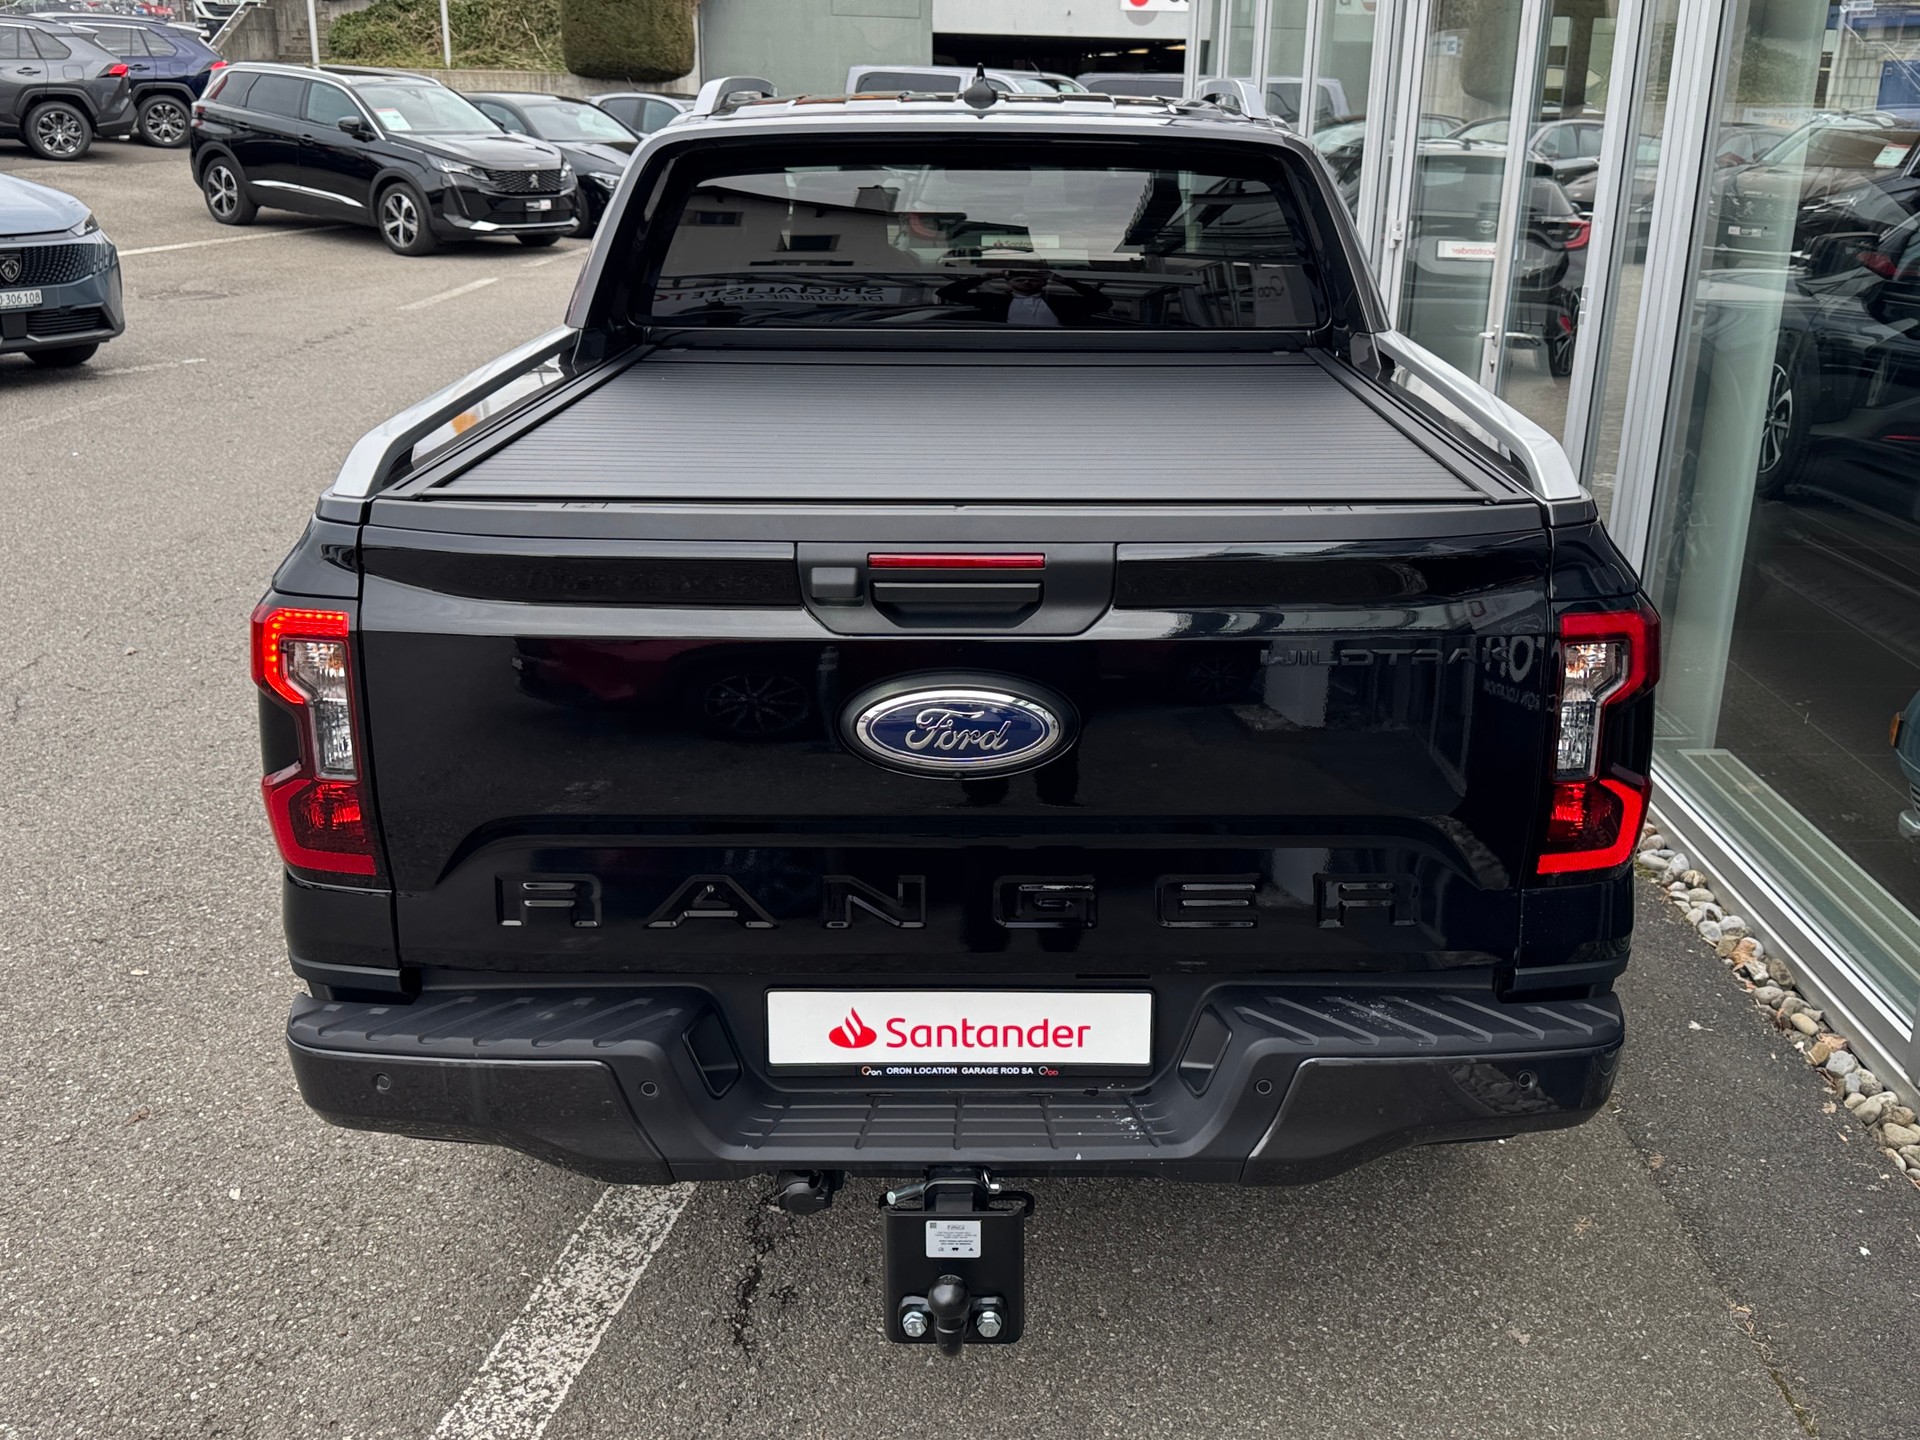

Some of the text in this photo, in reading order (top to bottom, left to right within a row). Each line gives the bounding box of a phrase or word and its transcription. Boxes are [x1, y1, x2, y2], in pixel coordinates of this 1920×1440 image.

[905, 708, 1011, 751] Ford
[495, 871, 1422, 928] RANGER
[886, 1018, 1091, 1049] Santander
[886, 1066, 912, 1075] ORON
[913, 1066, 958, 1075] LOCATION
[961, 1066, 999, 1075] GARAGE
[1000, 1066, 1020, 1075] ROD
[1021, 1066, 1034, 1075] SA
